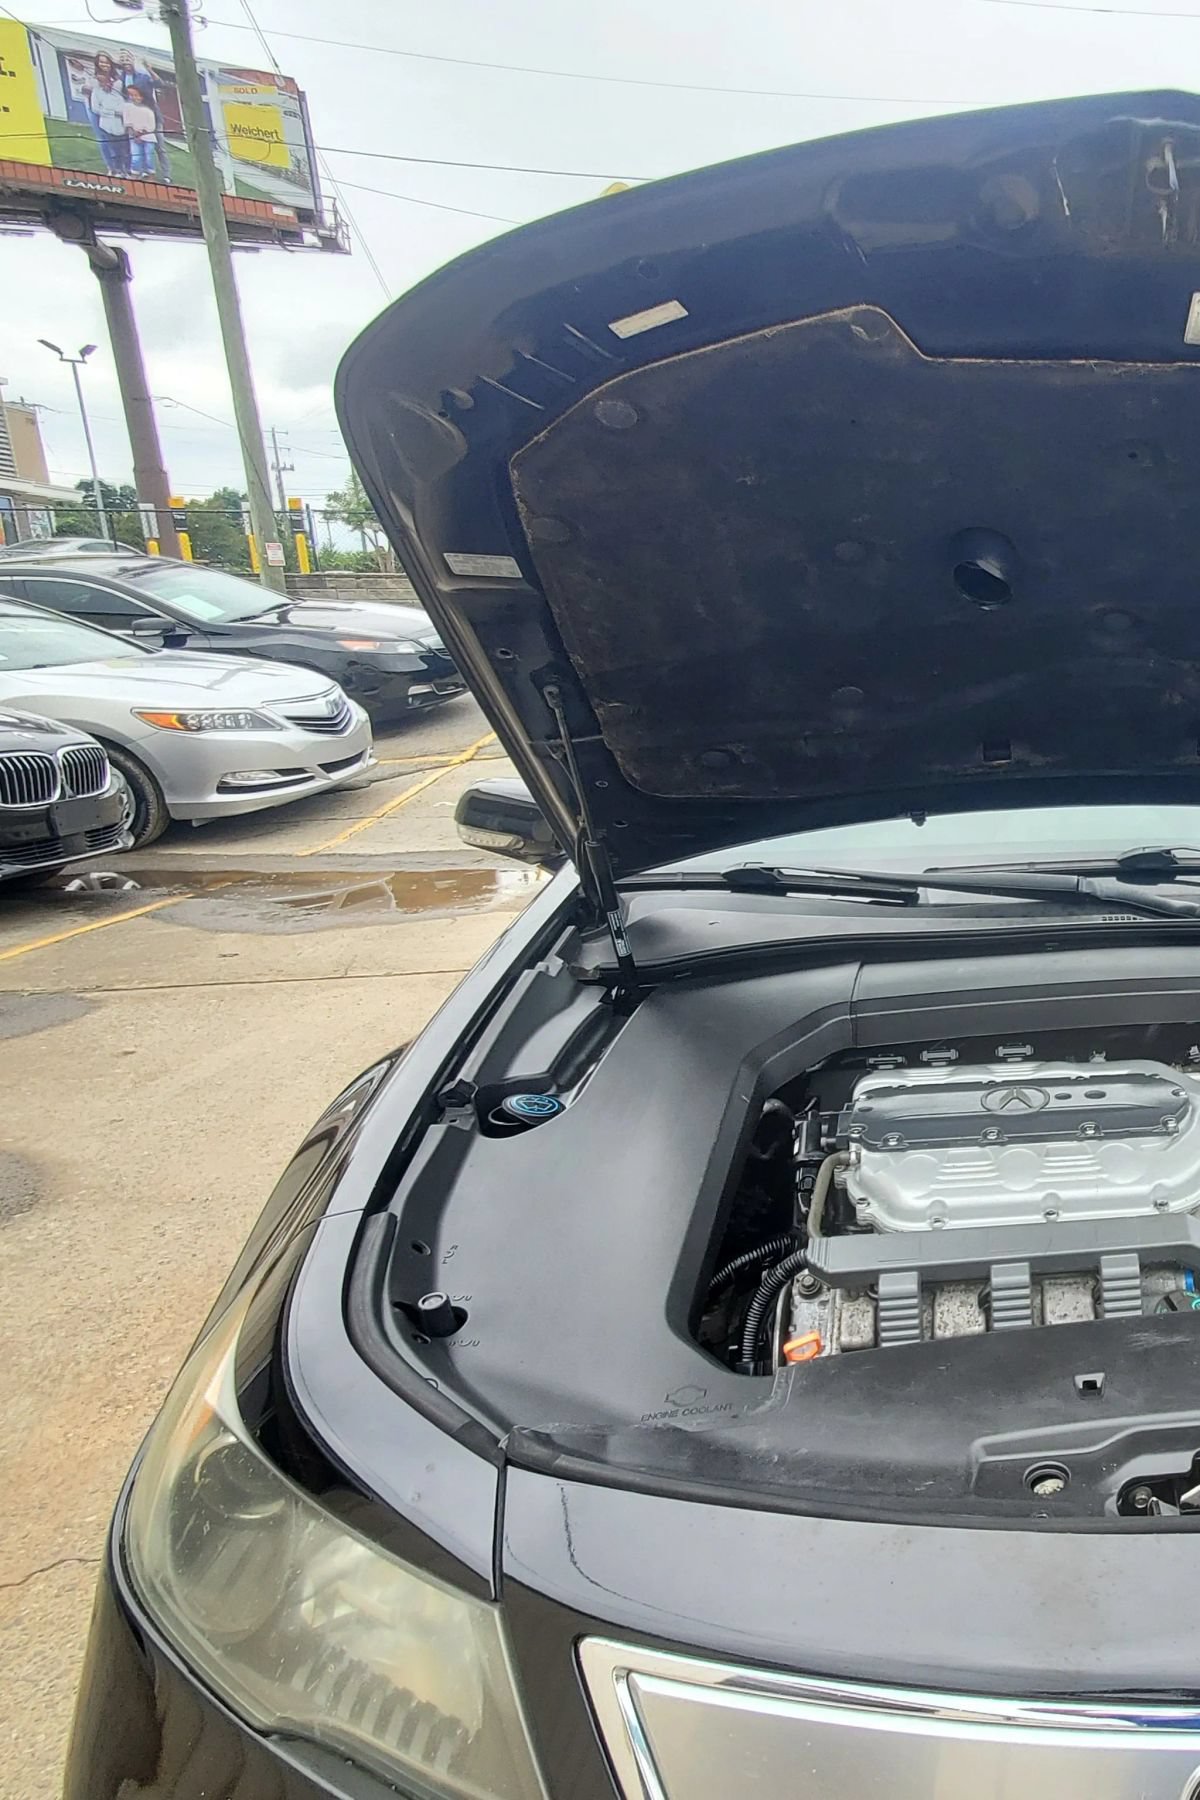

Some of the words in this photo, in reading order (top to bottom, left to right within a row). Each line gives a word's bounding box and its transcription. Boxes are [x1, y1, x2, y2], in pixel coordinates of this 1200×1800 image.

[66, 179, 122, 193] LAMAR
[640, 1409, 678, 1422] ENGINE
[681, 1402, 734, 1417] COOLANT
